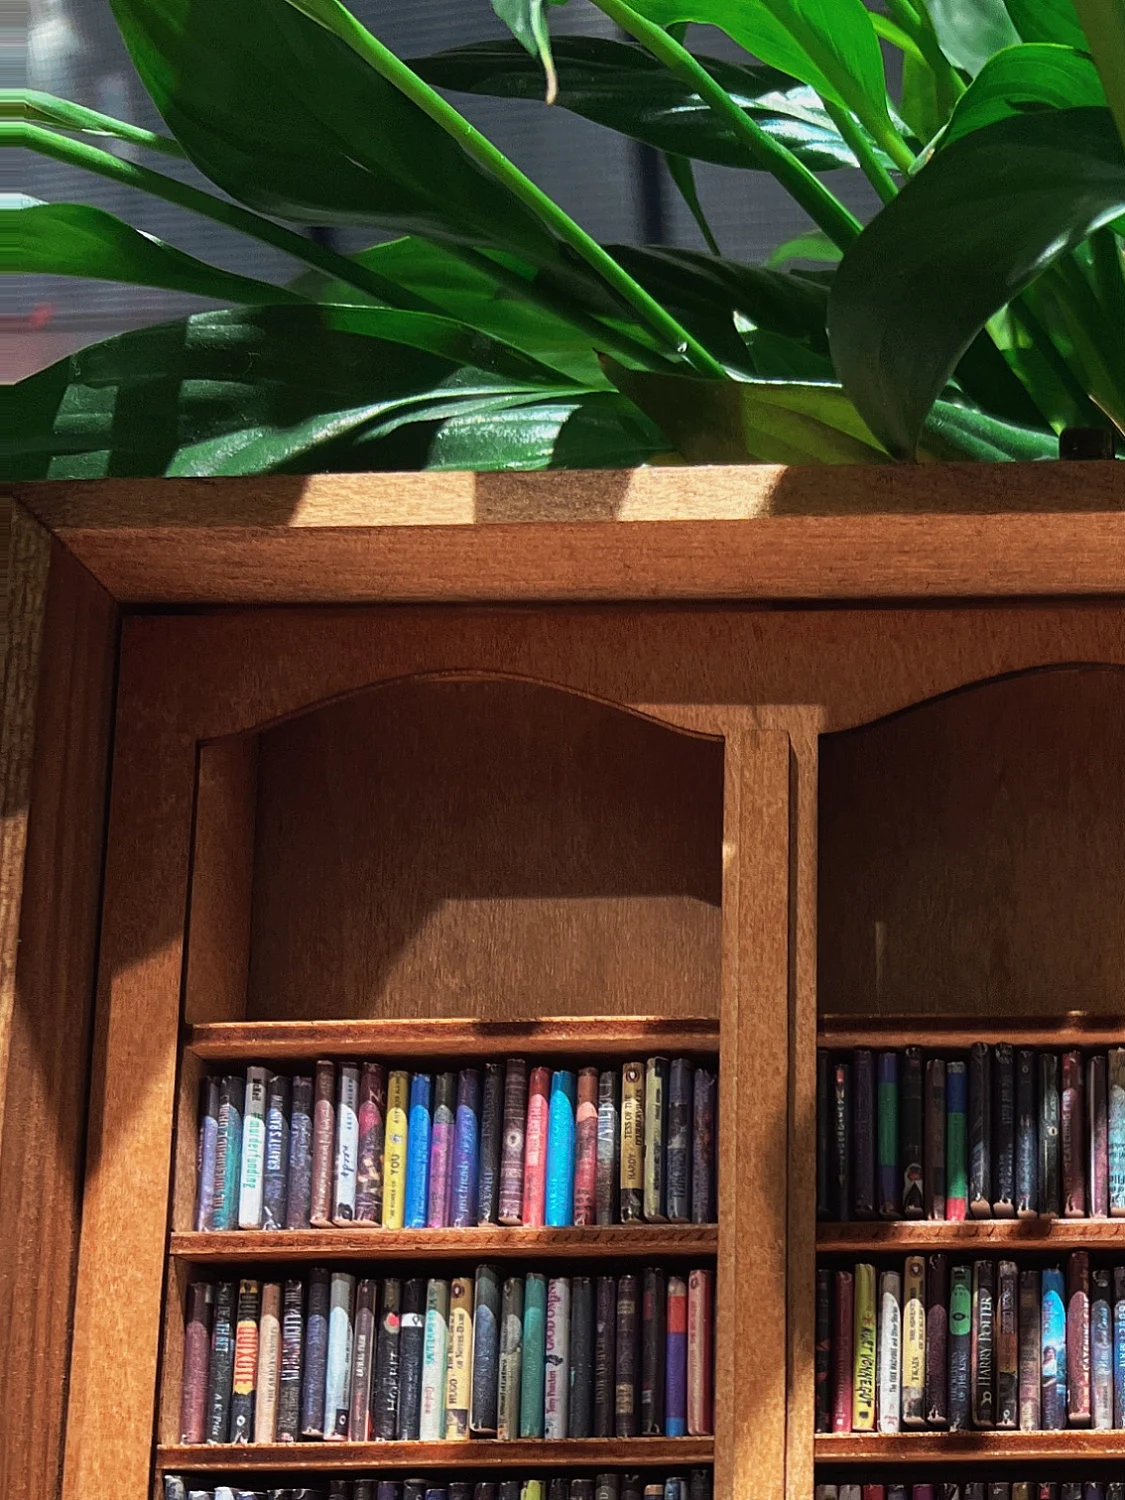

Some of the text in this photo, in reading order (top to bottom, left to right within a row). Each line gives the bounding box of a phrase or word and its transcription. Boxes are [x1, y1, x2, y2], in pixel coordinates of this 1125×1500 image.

[623, 1111, 632, 1121] OF
[623, 1123, 632, 1140] TESS
[391, 1153, 400, 1176] YOU
[627, 1154, 636, 1180] HARDY
[978, 1296, 992, 1386] HARRY POTTER
[236, 1327, 257, 1385] QUIXOTE
[449, 1379, 457, 1404] HUGO
[857, 1353, 874, 1408] VONNEGUT
